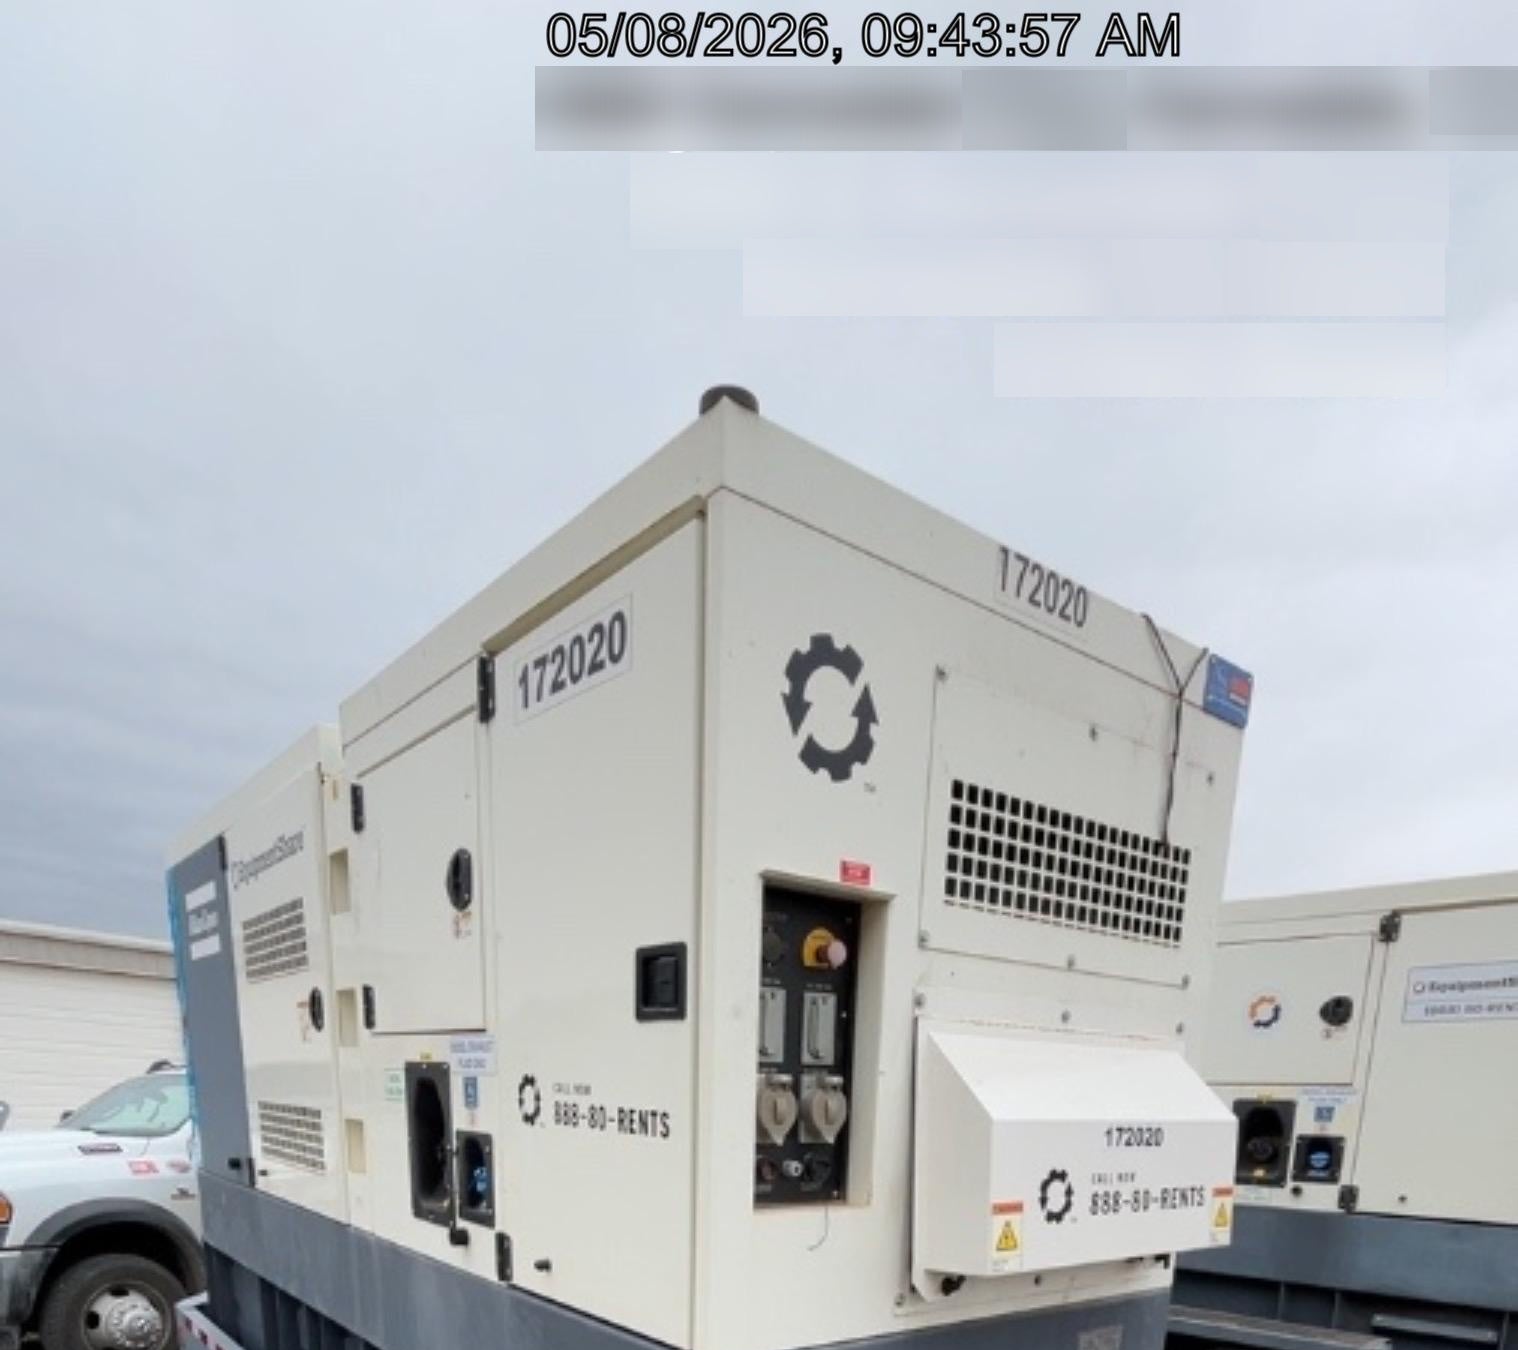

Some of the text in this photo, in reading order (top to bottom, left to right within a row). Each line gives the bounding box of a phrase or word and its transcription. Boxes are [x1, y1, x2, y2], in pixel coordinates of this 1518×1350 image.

[999, 544, 1088, 628] 172020
[518, 609, 627, 710] 172020
[554, 1100, 671, 1140] 888-80-RENTS
[1105, 1126, 1164, 1148] 172020
[1089, 1186, 1206, 1216] 888-80-RENTS
